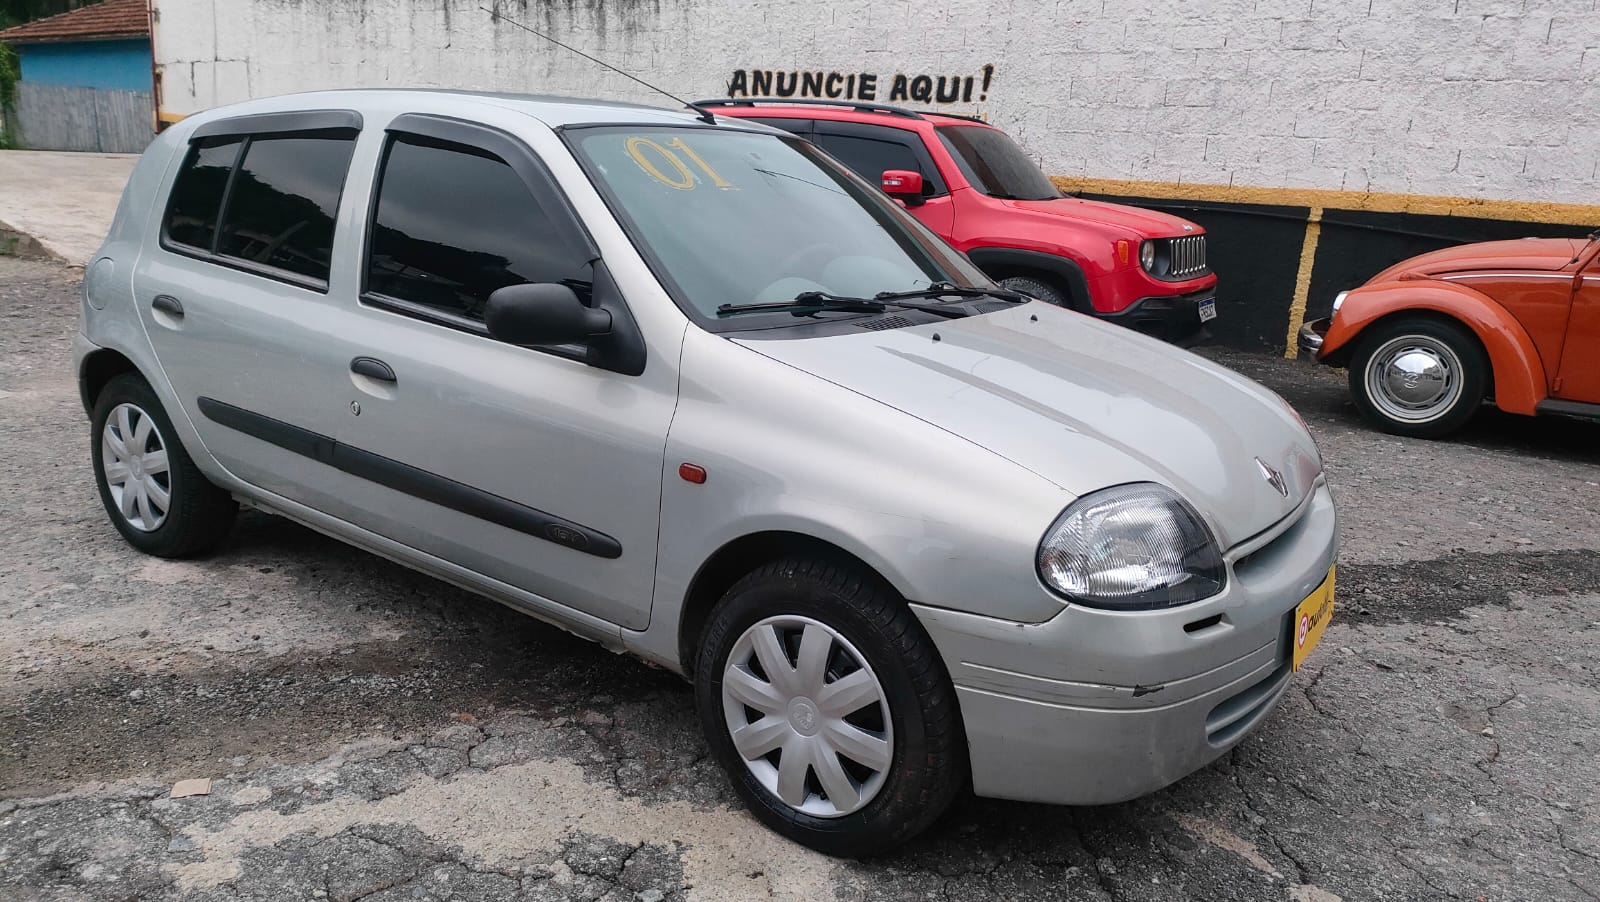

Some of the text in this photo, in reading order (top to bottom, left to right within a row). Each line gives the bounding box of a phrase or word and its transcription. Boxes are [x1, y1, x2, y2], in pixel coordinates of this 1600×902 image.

[730, 63, 995, 104] ANUNCIE AQUI!
[625, 136, 735, 190] 01
